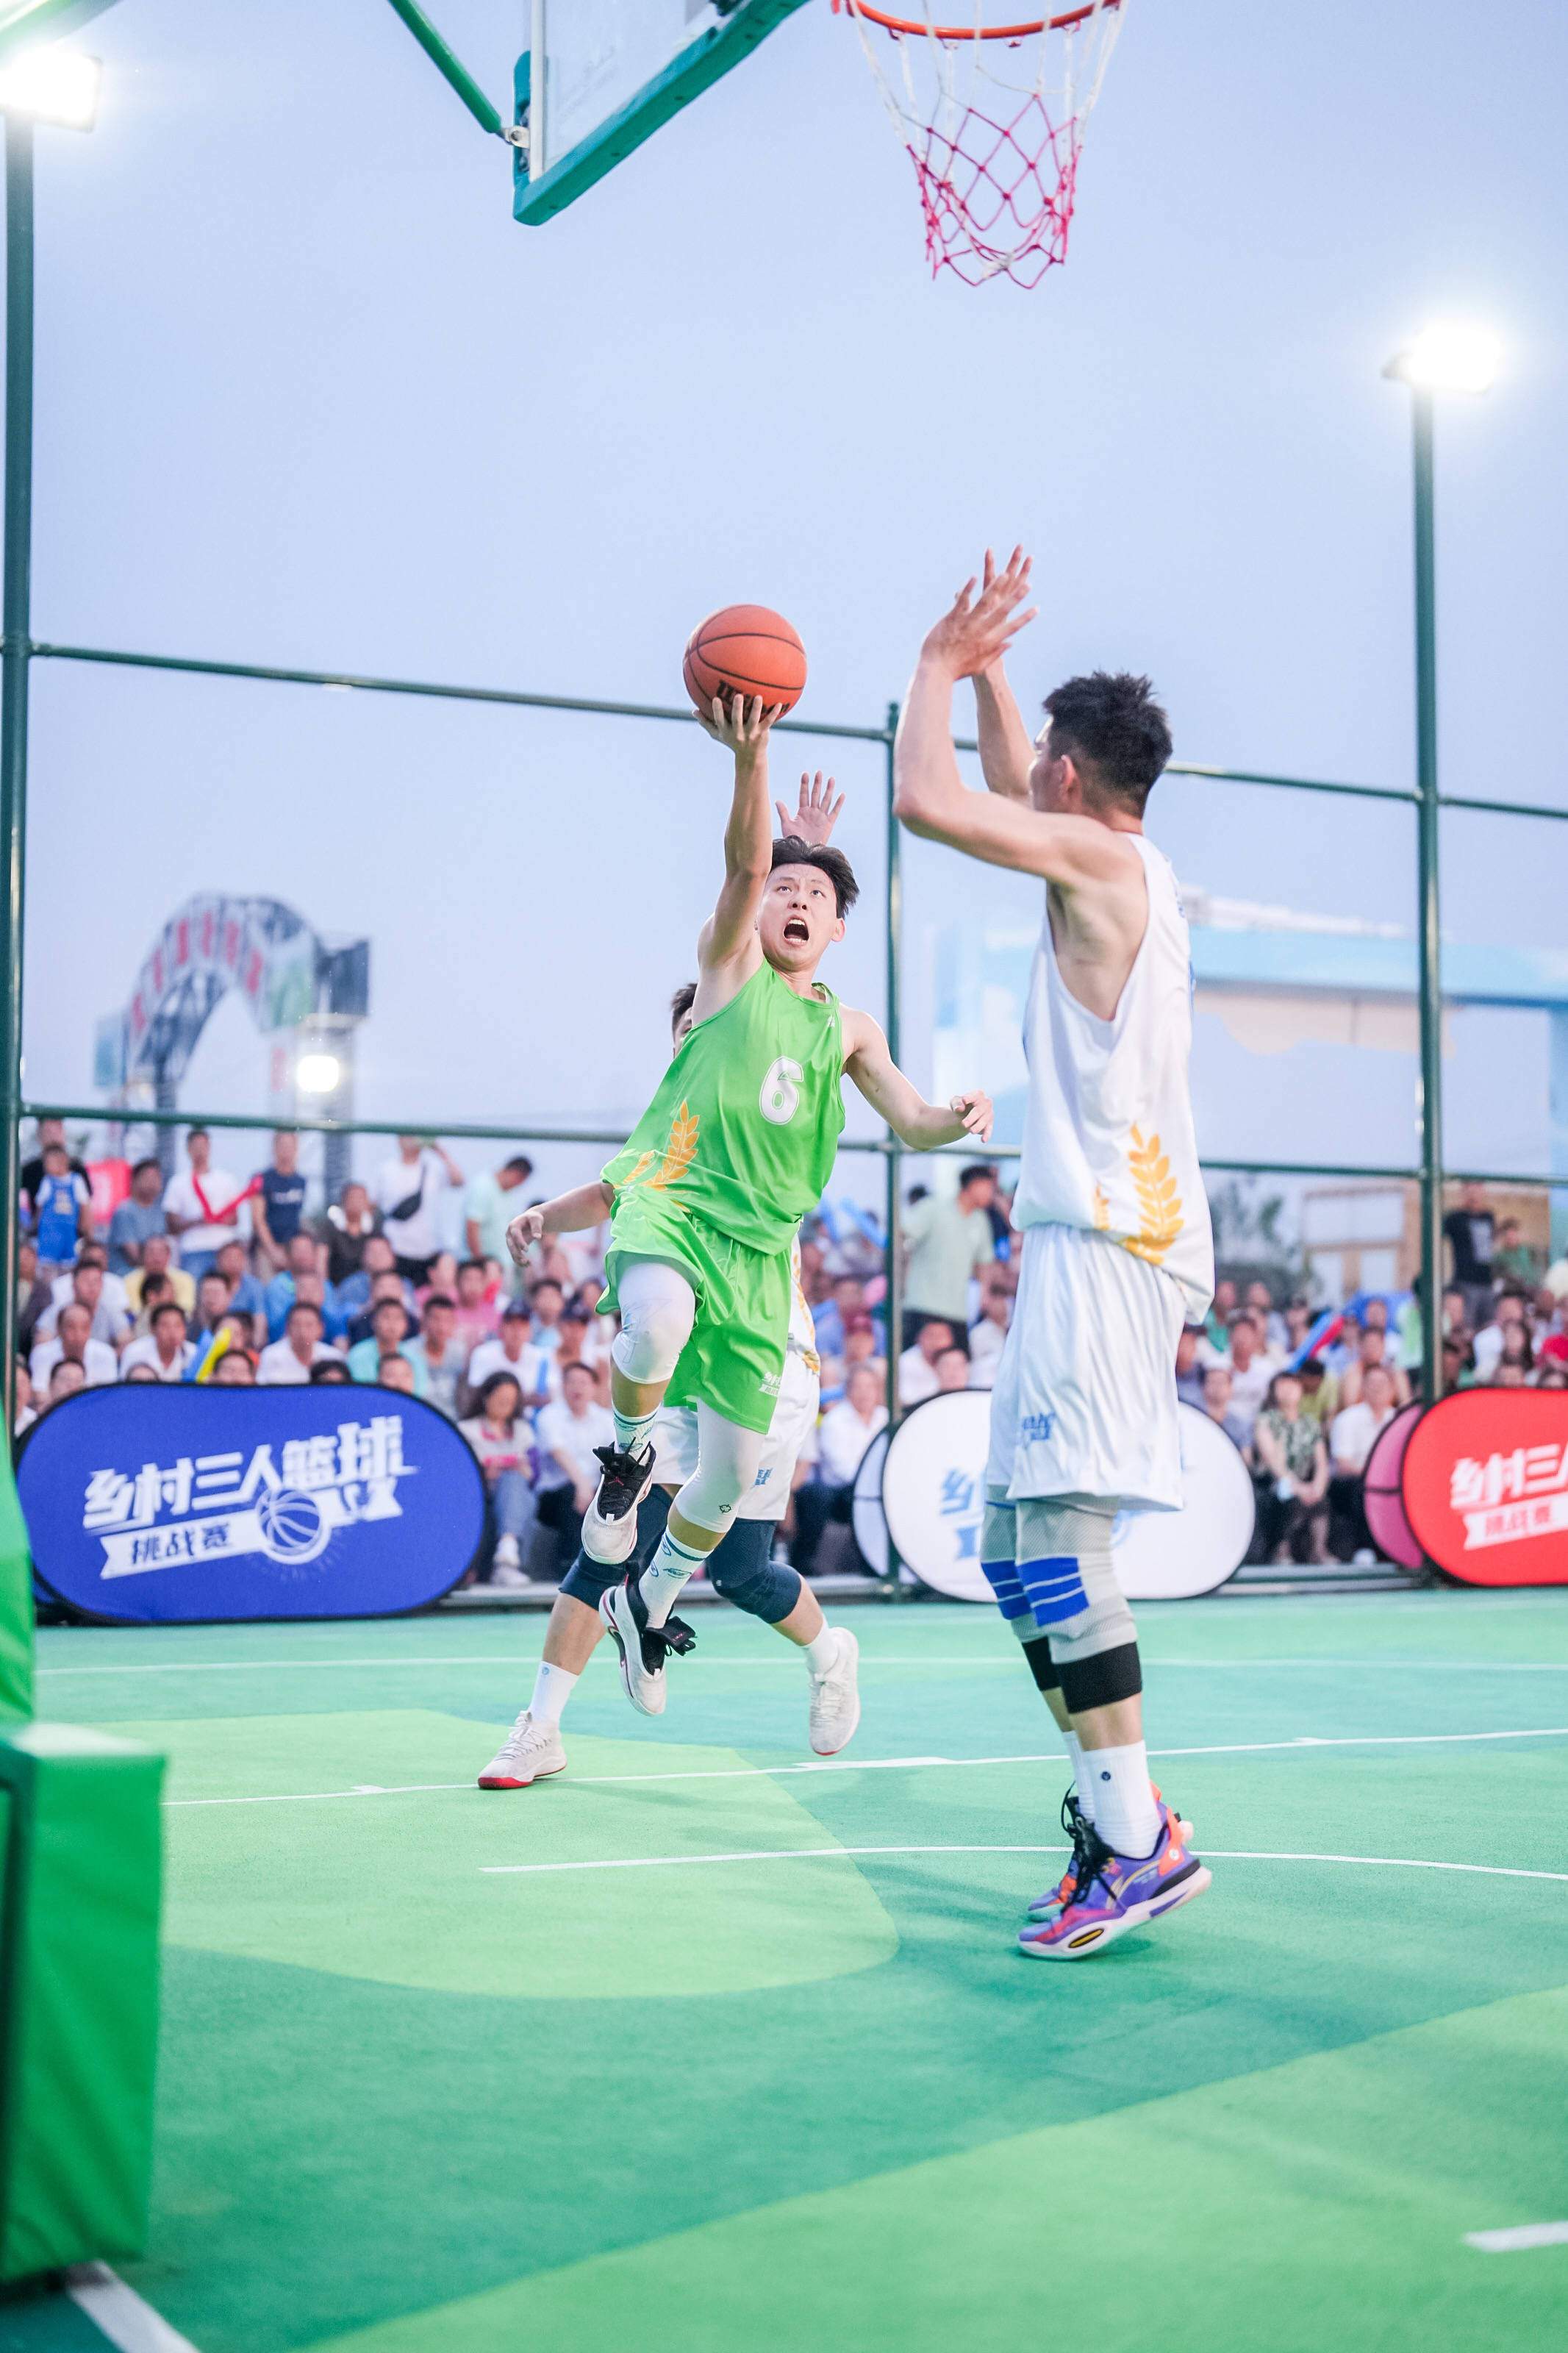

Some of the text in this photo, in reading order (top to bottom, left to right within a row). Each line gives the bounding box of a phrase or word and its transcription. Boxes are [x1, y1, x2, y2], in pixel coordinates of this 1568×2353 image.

[759, 1055, 804, 1125] 6
[83, 1415, 418, 1531] 乡村三人篮球
